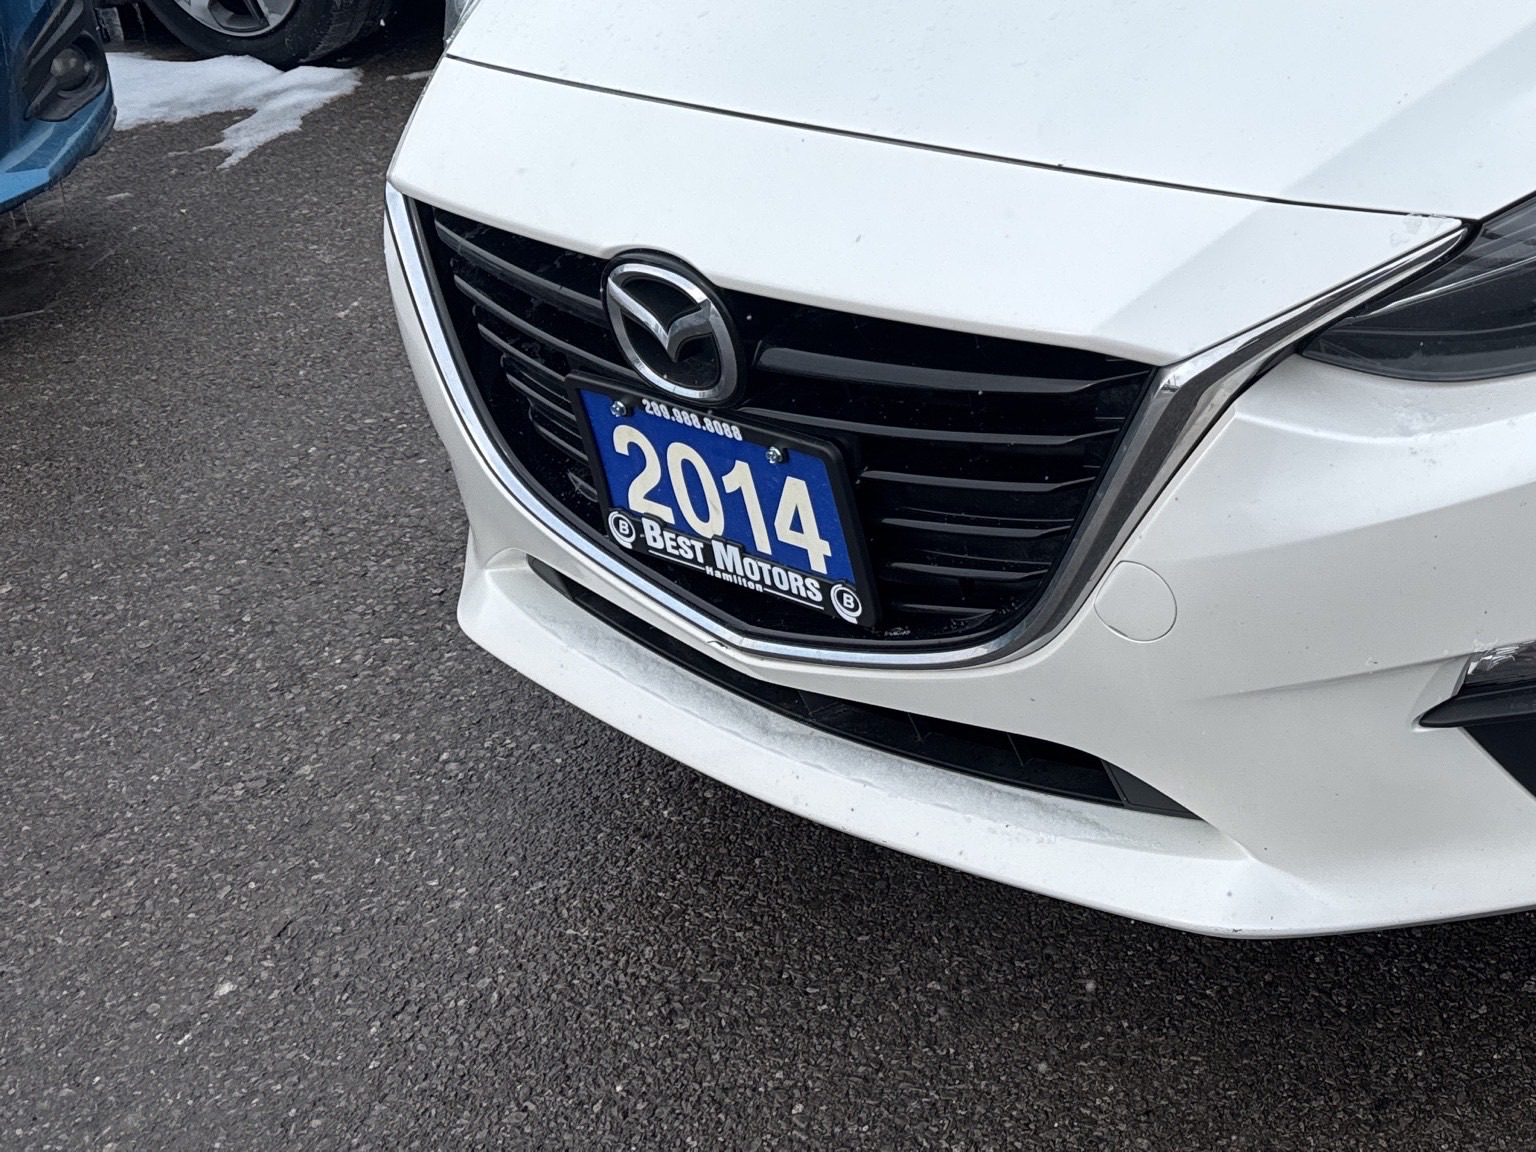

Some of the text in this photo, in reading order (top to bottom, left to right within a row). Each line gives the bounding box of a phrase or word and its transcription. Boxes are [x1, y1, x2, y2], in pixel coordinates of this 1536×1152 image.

[641, 398, 743, 442] 289.988.8088
[612, 424, 832, 574] 2014
[641, 517, 823, 602] BEST MOTORS
[705, 565, 764, 593] Hamilton
